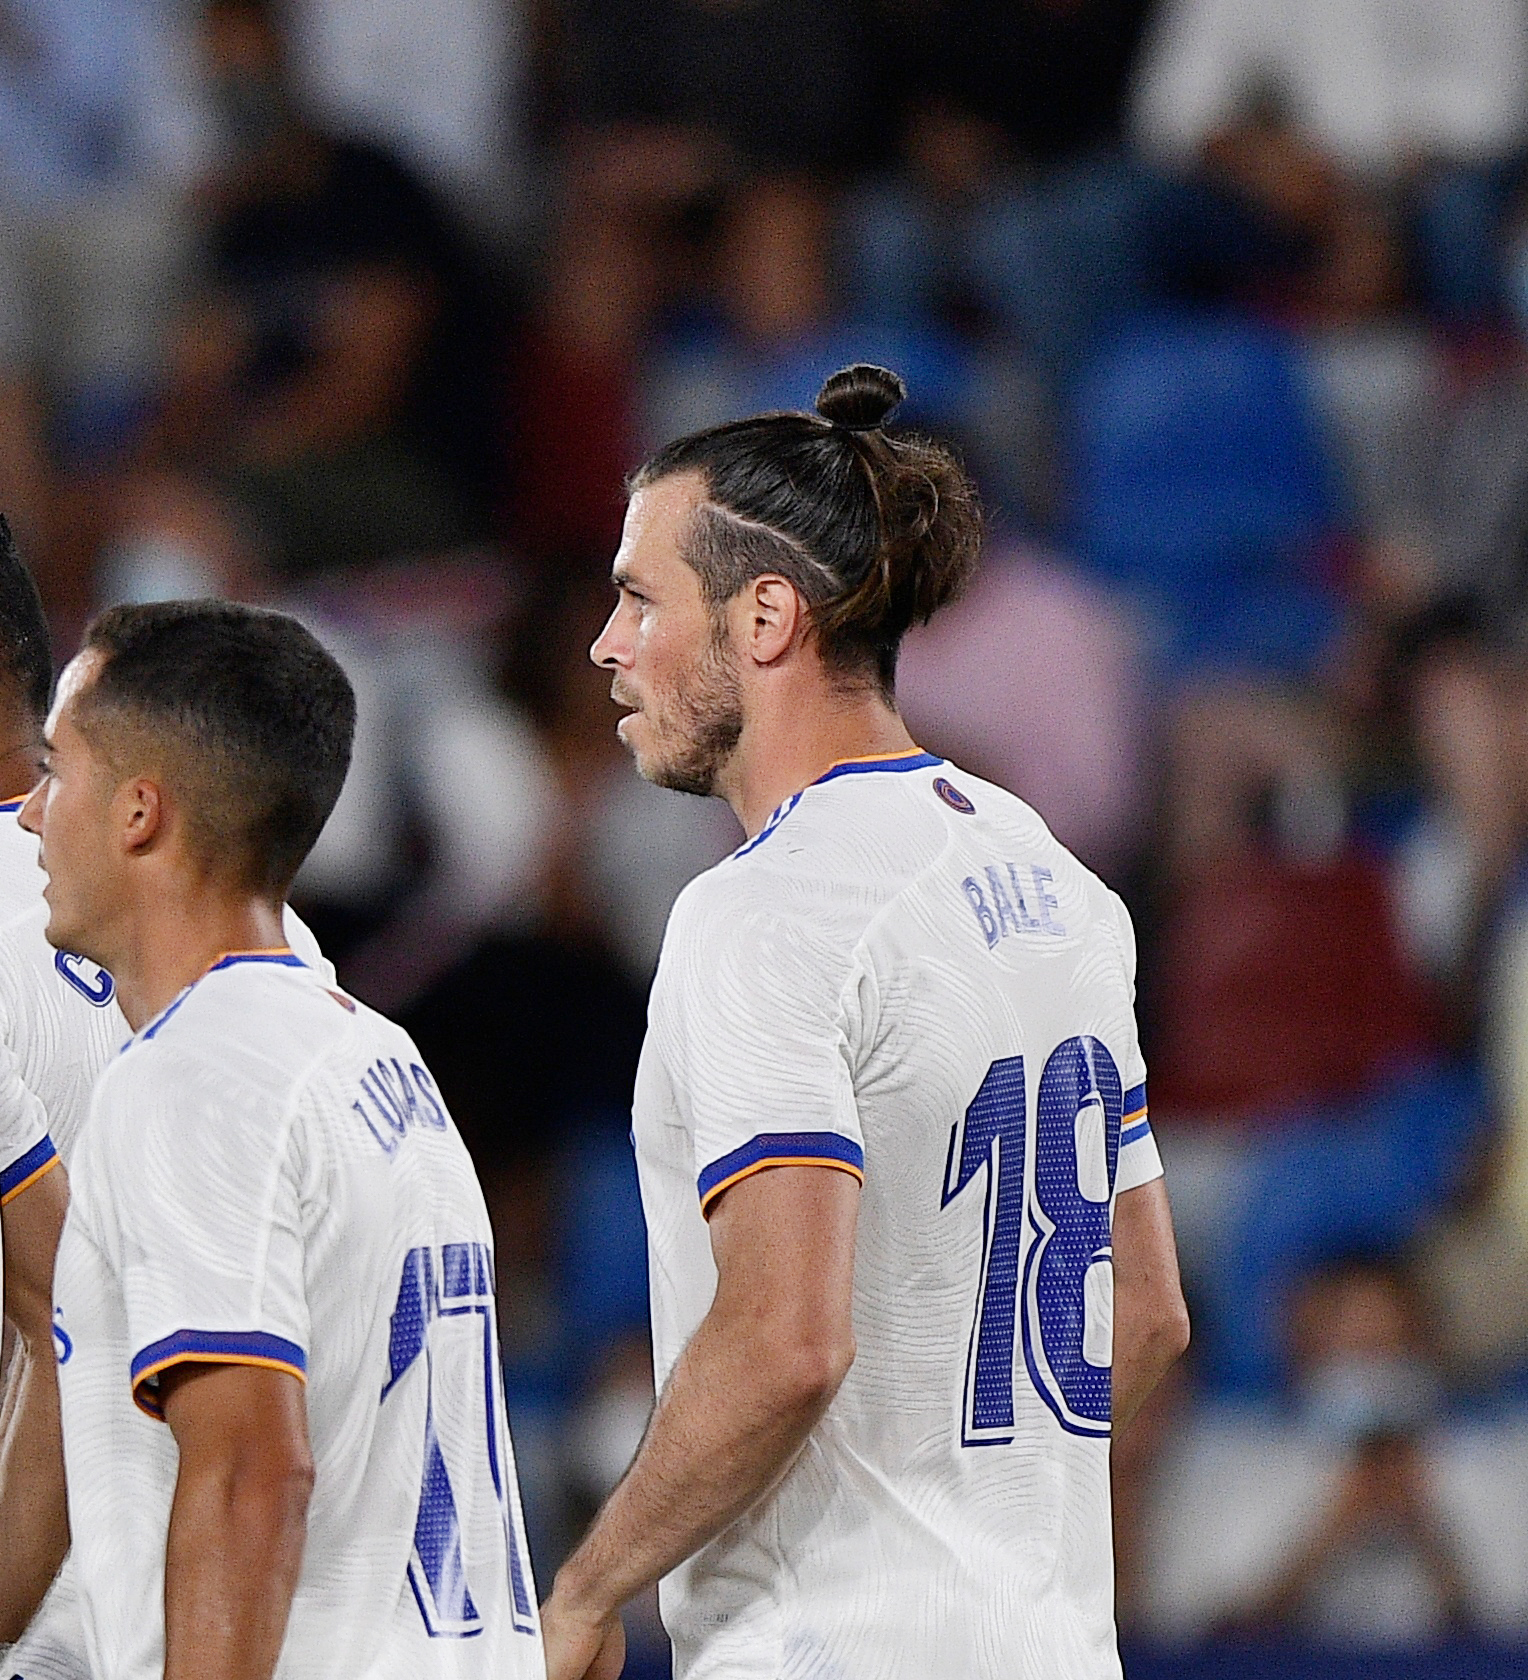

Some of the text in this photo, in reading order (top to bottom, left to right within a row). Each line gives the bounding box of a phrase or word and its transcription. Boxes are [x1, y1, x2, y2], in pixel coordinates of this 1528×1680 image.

[961, 862, 1066, 950] BALE
[352, 1057, 447, 1153] LUCAS
[941, 1035, 1123, 1447] 18
[380, 1242, 537, 1638] 17
